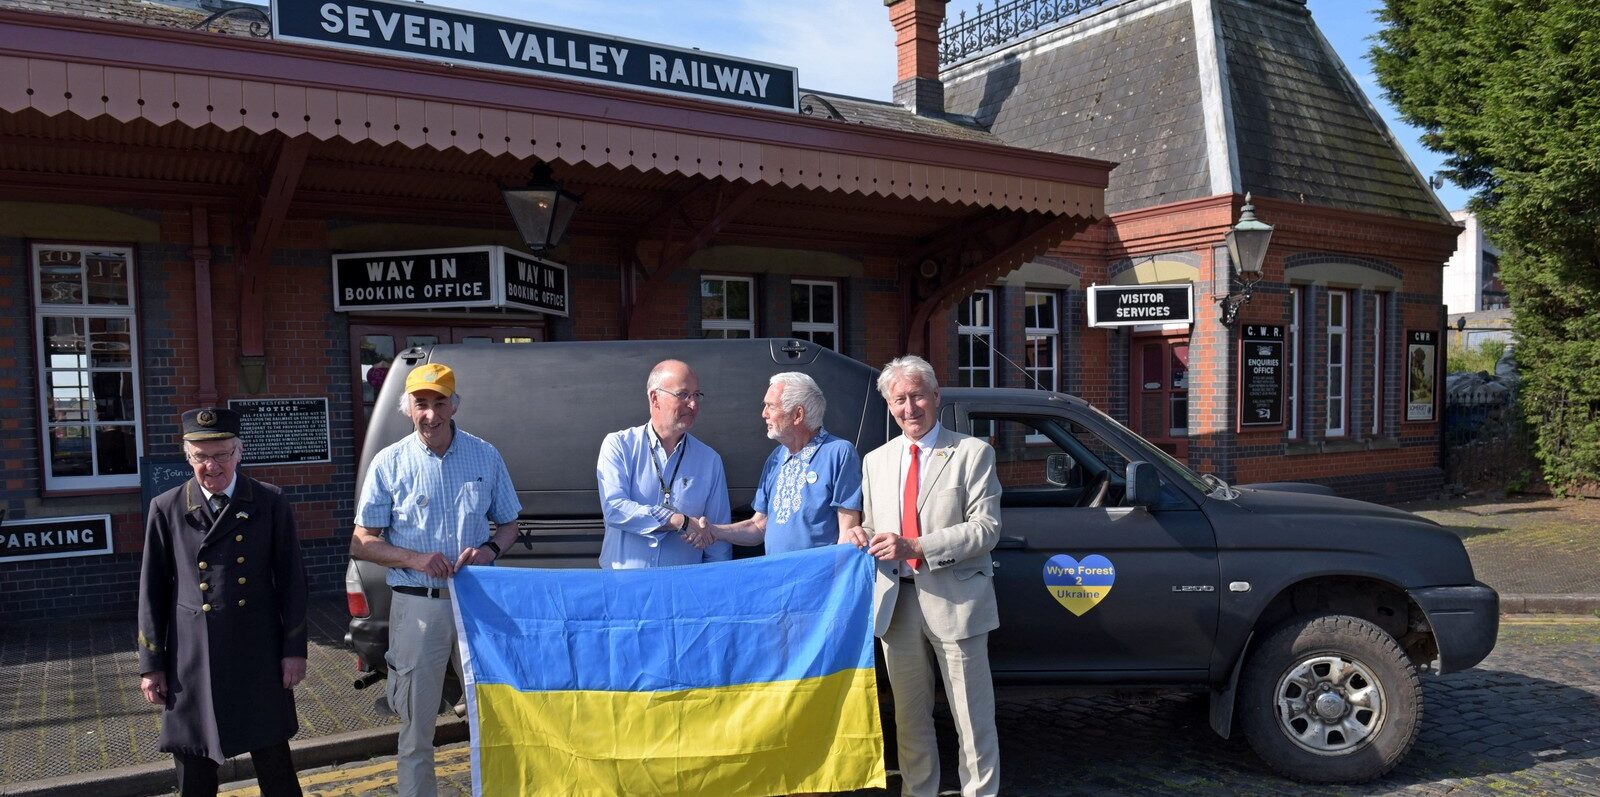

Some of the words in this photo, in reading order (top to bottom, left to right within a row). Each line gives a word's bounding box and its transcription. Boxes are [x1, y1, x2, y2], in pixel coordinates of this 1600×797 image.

[320, 2, 475, 54] SEVERN
[498, 29, 628, 76] VALLEY
[649, 53, 771, 98] RAILWAY
[366, 260, 415, 282] WAY
[430, 258, 457, 279] IN
[517, 261, 539, 286] WAY
[543, 268, 555, 288] IN
[345, 285, 415, 301] BOOKING
[423, 282, 483, 298] OFFICE
[508, 282, 539, 302] BOOKING
[542, 291, 564, 307] OFFICE
[1121, 293, 1164, 304] VISITOR
[1116, 306, 1170, 317] SERVICES
[1248, 358, 1279, 367] ENQUIRIES
[163, 468, 183, 480] Join
[1047, 566, 1075, 577] Wyre
[1078, 565, 1114, 575] Forest
[1075, 576, 1083, 586] 2
[1057, 589, 1100, 599] Ukraine
